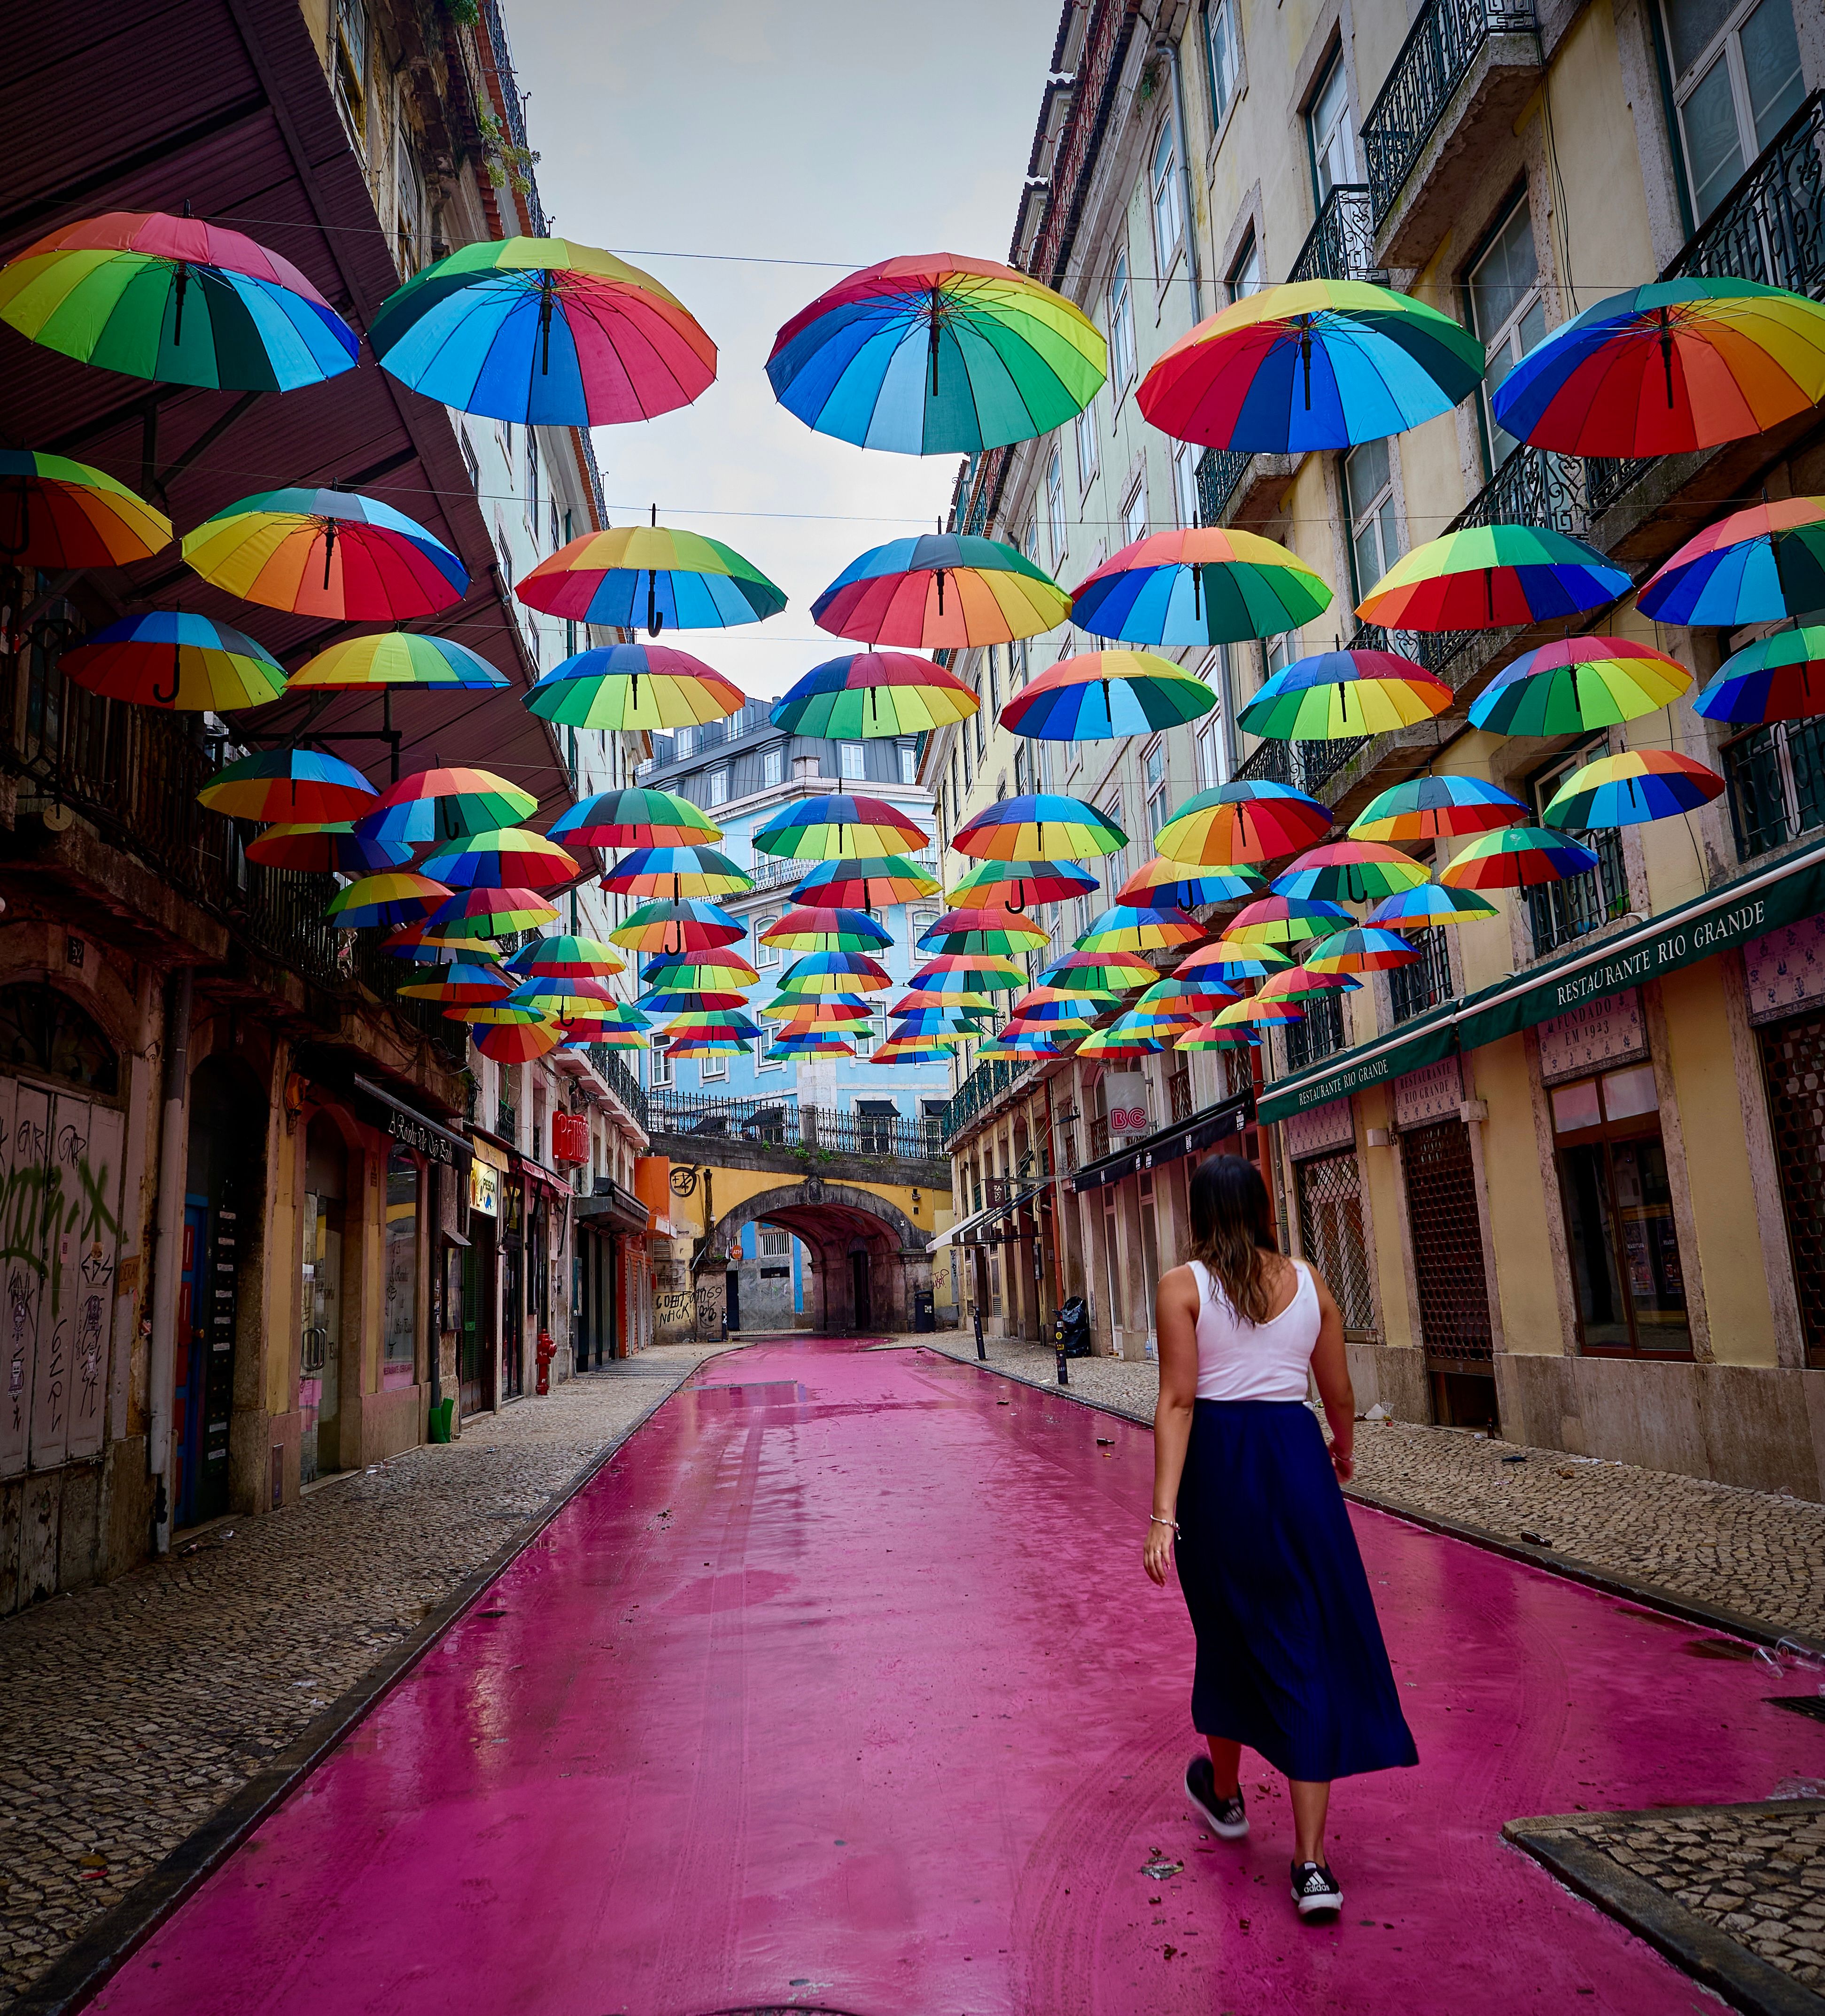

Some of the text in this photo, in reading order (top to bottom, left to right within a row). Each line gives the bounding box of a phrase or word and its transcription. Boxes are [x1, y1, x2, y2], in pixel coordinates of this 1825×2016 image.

[1556, 900, 1765, 1005] RESTAURANTE RIO GRANDE
[1557, 998, 1611, 1029] FUNDADO
[1565, 1020, 1609, 1046] EM 1923
[1299, 1059, 1389, 1106] RESTAURANTE RIO GRANDE
[1400, 1062, 1451, 1090] RESTAURANTE
[1405, 1080, 1449, 1104] RIO GRANDE
[1111, 1107, 1146, 1129] BC
[484, 1178, 495, 1194] PESCA
[1304, 1884, 1330, 1893] adidas
